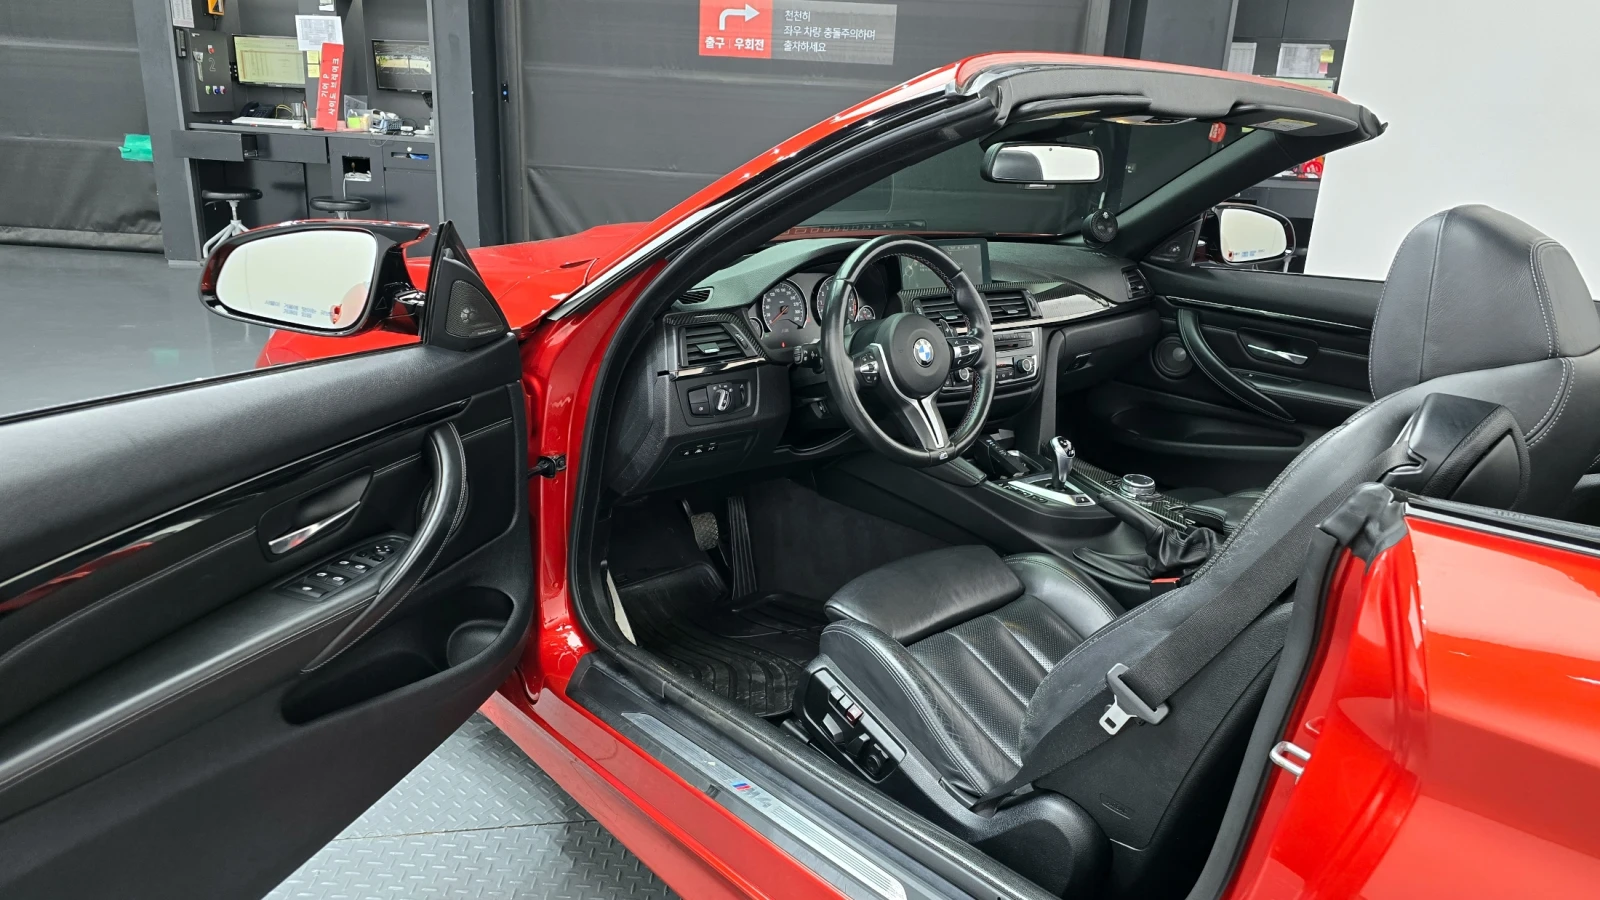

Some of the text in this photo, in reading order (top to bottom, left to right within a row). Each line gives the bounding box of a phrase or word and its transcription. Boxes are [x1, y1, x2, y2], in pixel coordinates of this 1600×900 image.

[784, 10, 811, 22] 천천히
[783, 25, 876, 41] 좌우 차량 충돌주의하며
[704, 36, 765, 51] 출구 우회전
[783, 40, 827, 53] 출차하세요
[208, 57, 217, 72] 2
[321, 82, 330, 98] 기어
[328, 57, 340, 116] 사이드 브레이크
